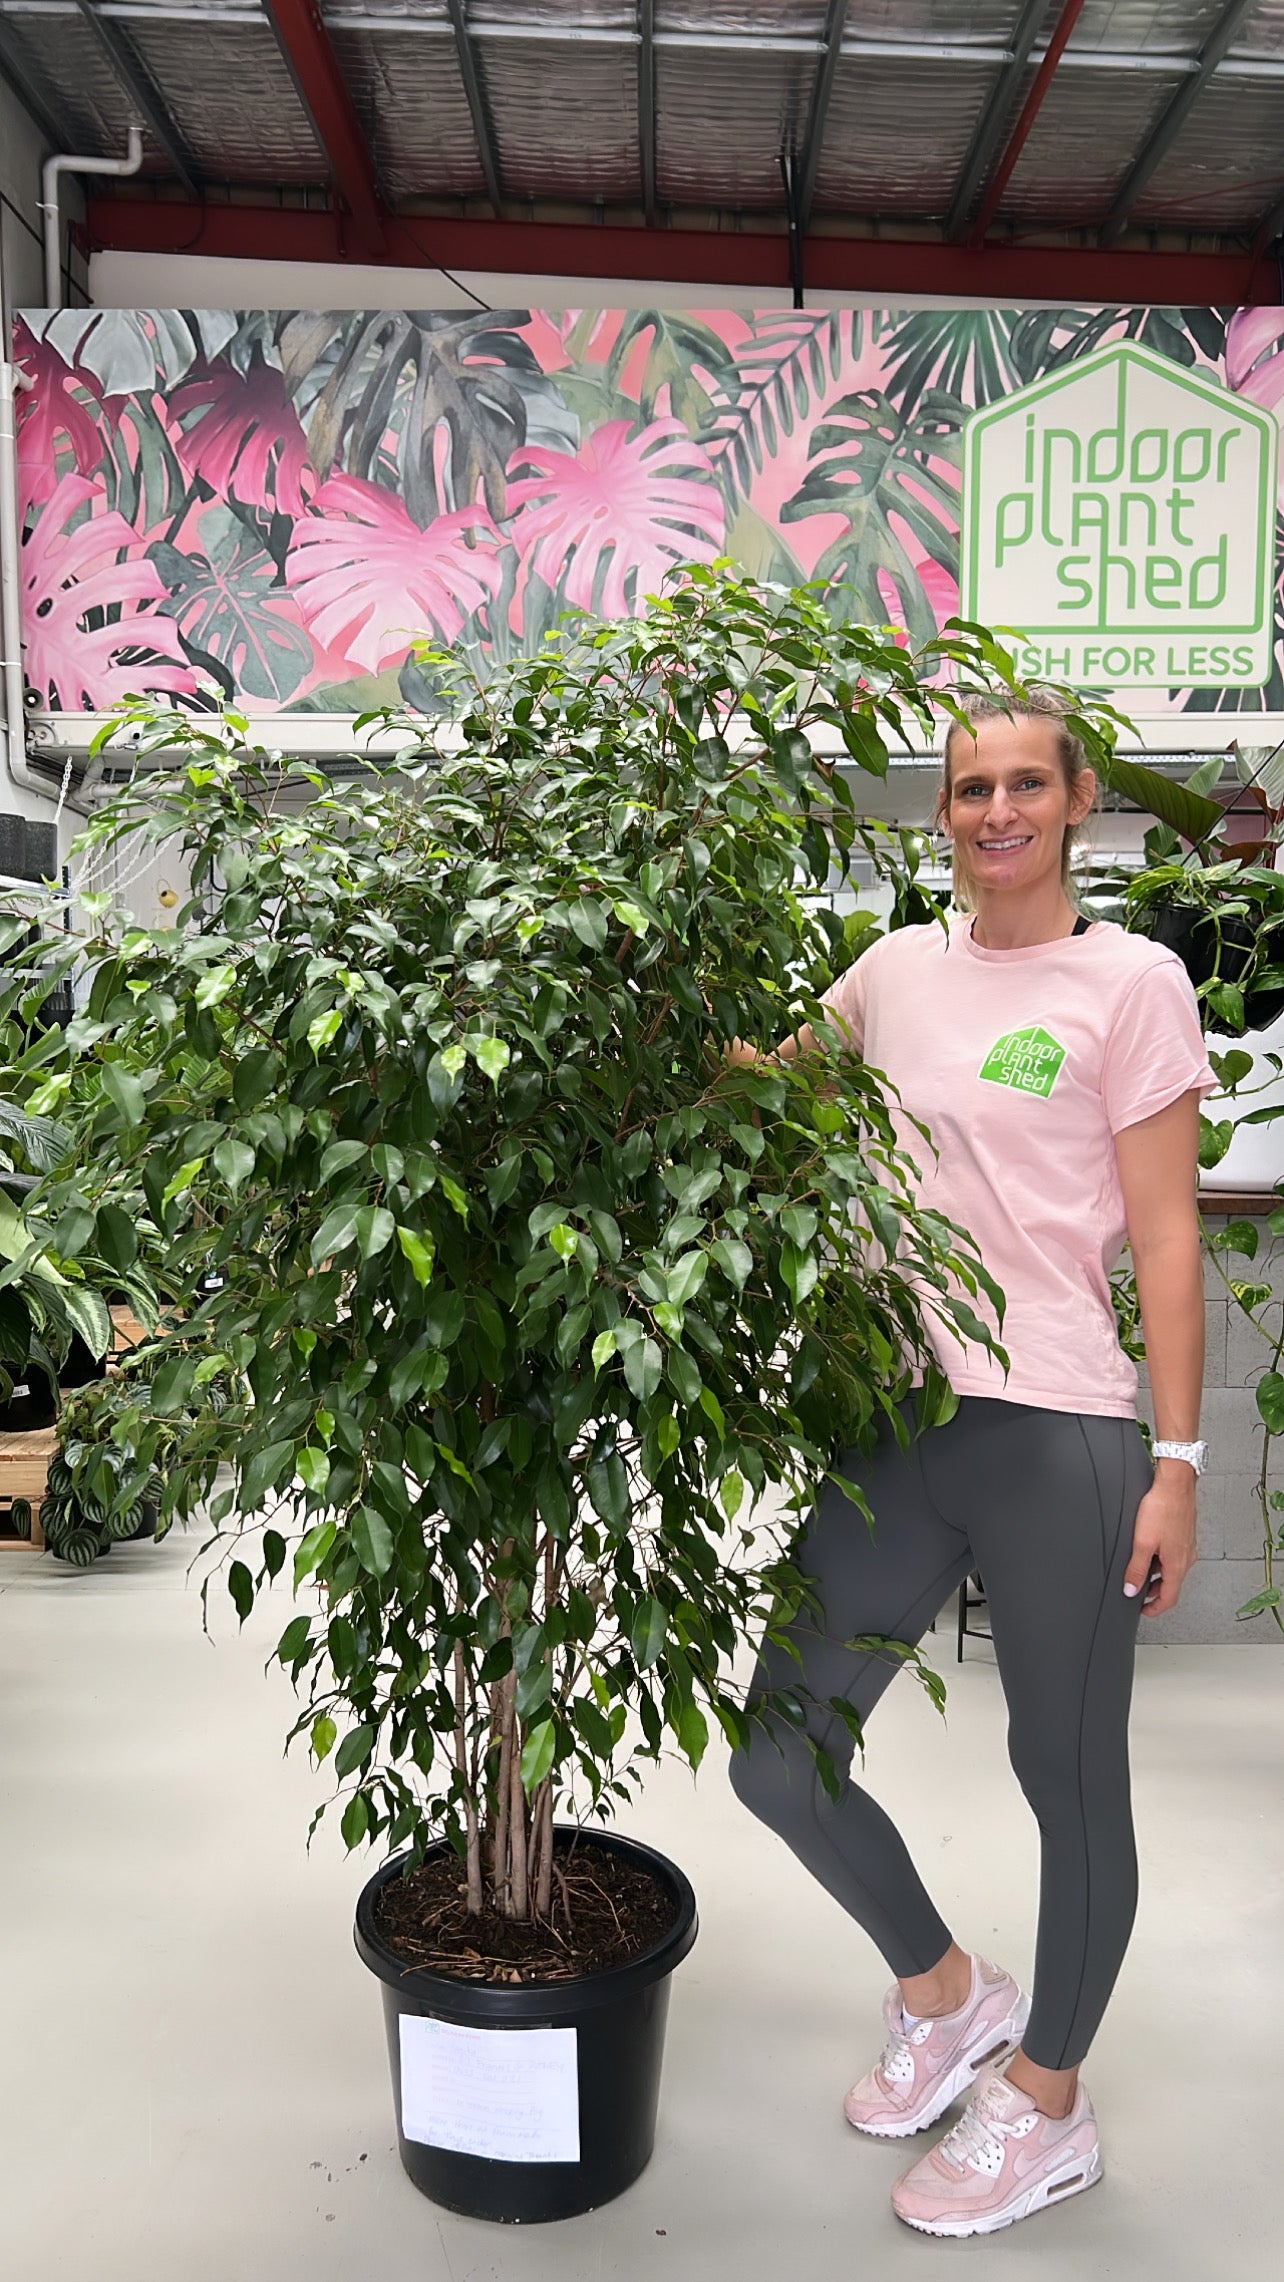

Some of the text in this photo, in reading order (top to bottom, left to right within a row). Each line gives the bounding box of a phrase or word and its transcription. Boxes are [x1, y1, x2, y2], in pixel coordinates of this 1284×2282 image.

[1025, 413, 1242, 484] indoor
[1056, 533, 1229, 610] shed
[1083, 645, 1156, 676] FOR
[1167, 645, 1254, 677] LESS
[1003, 1033, 1062, 1062] indoor
[998, 1066, 1049, 1091] shed
